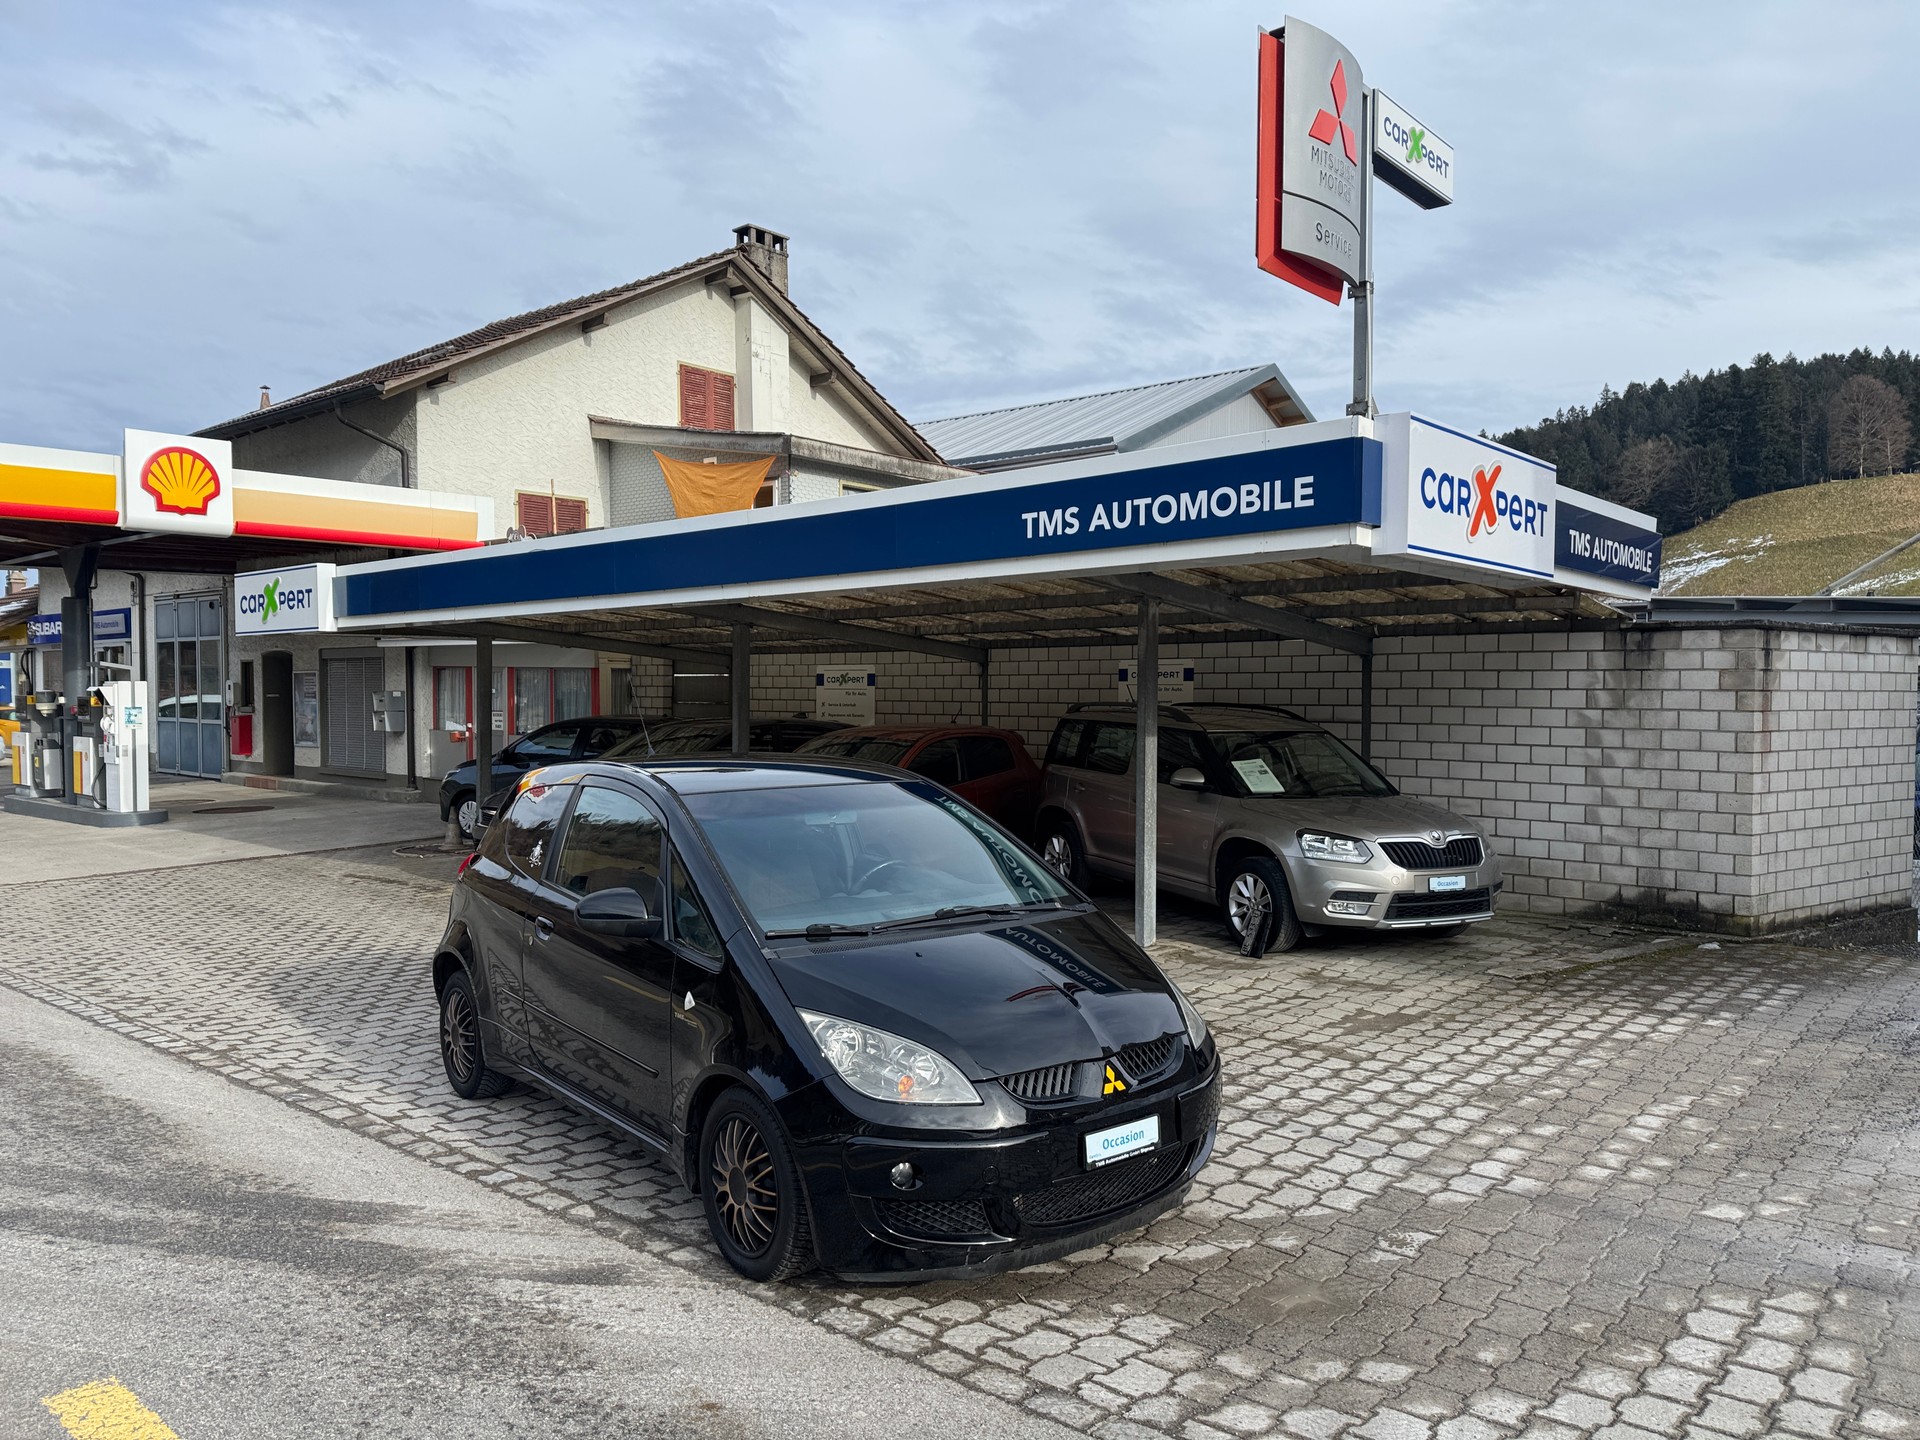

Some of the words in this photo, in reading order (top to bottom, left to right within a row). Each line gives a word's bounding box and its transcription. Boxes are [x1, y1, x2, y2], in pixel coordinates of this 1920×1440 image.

[1311, 145, 1355, 182] MITSUBISH
[1320, 170, 1352, 203] MOTORS
[1315, 222, 1352, 257] Service
[1022, 507, 1079, 538] TMS
[1089, 475, 1314, 531] AUTOMOBILE
[1569, 529, 1591, 558] TMS
[1592, 537, 1653, 573] AUTOMOBILE
[35, 621, 62, 636] SUBAR
[1102, 1129, 1145, 1150] Occasion
